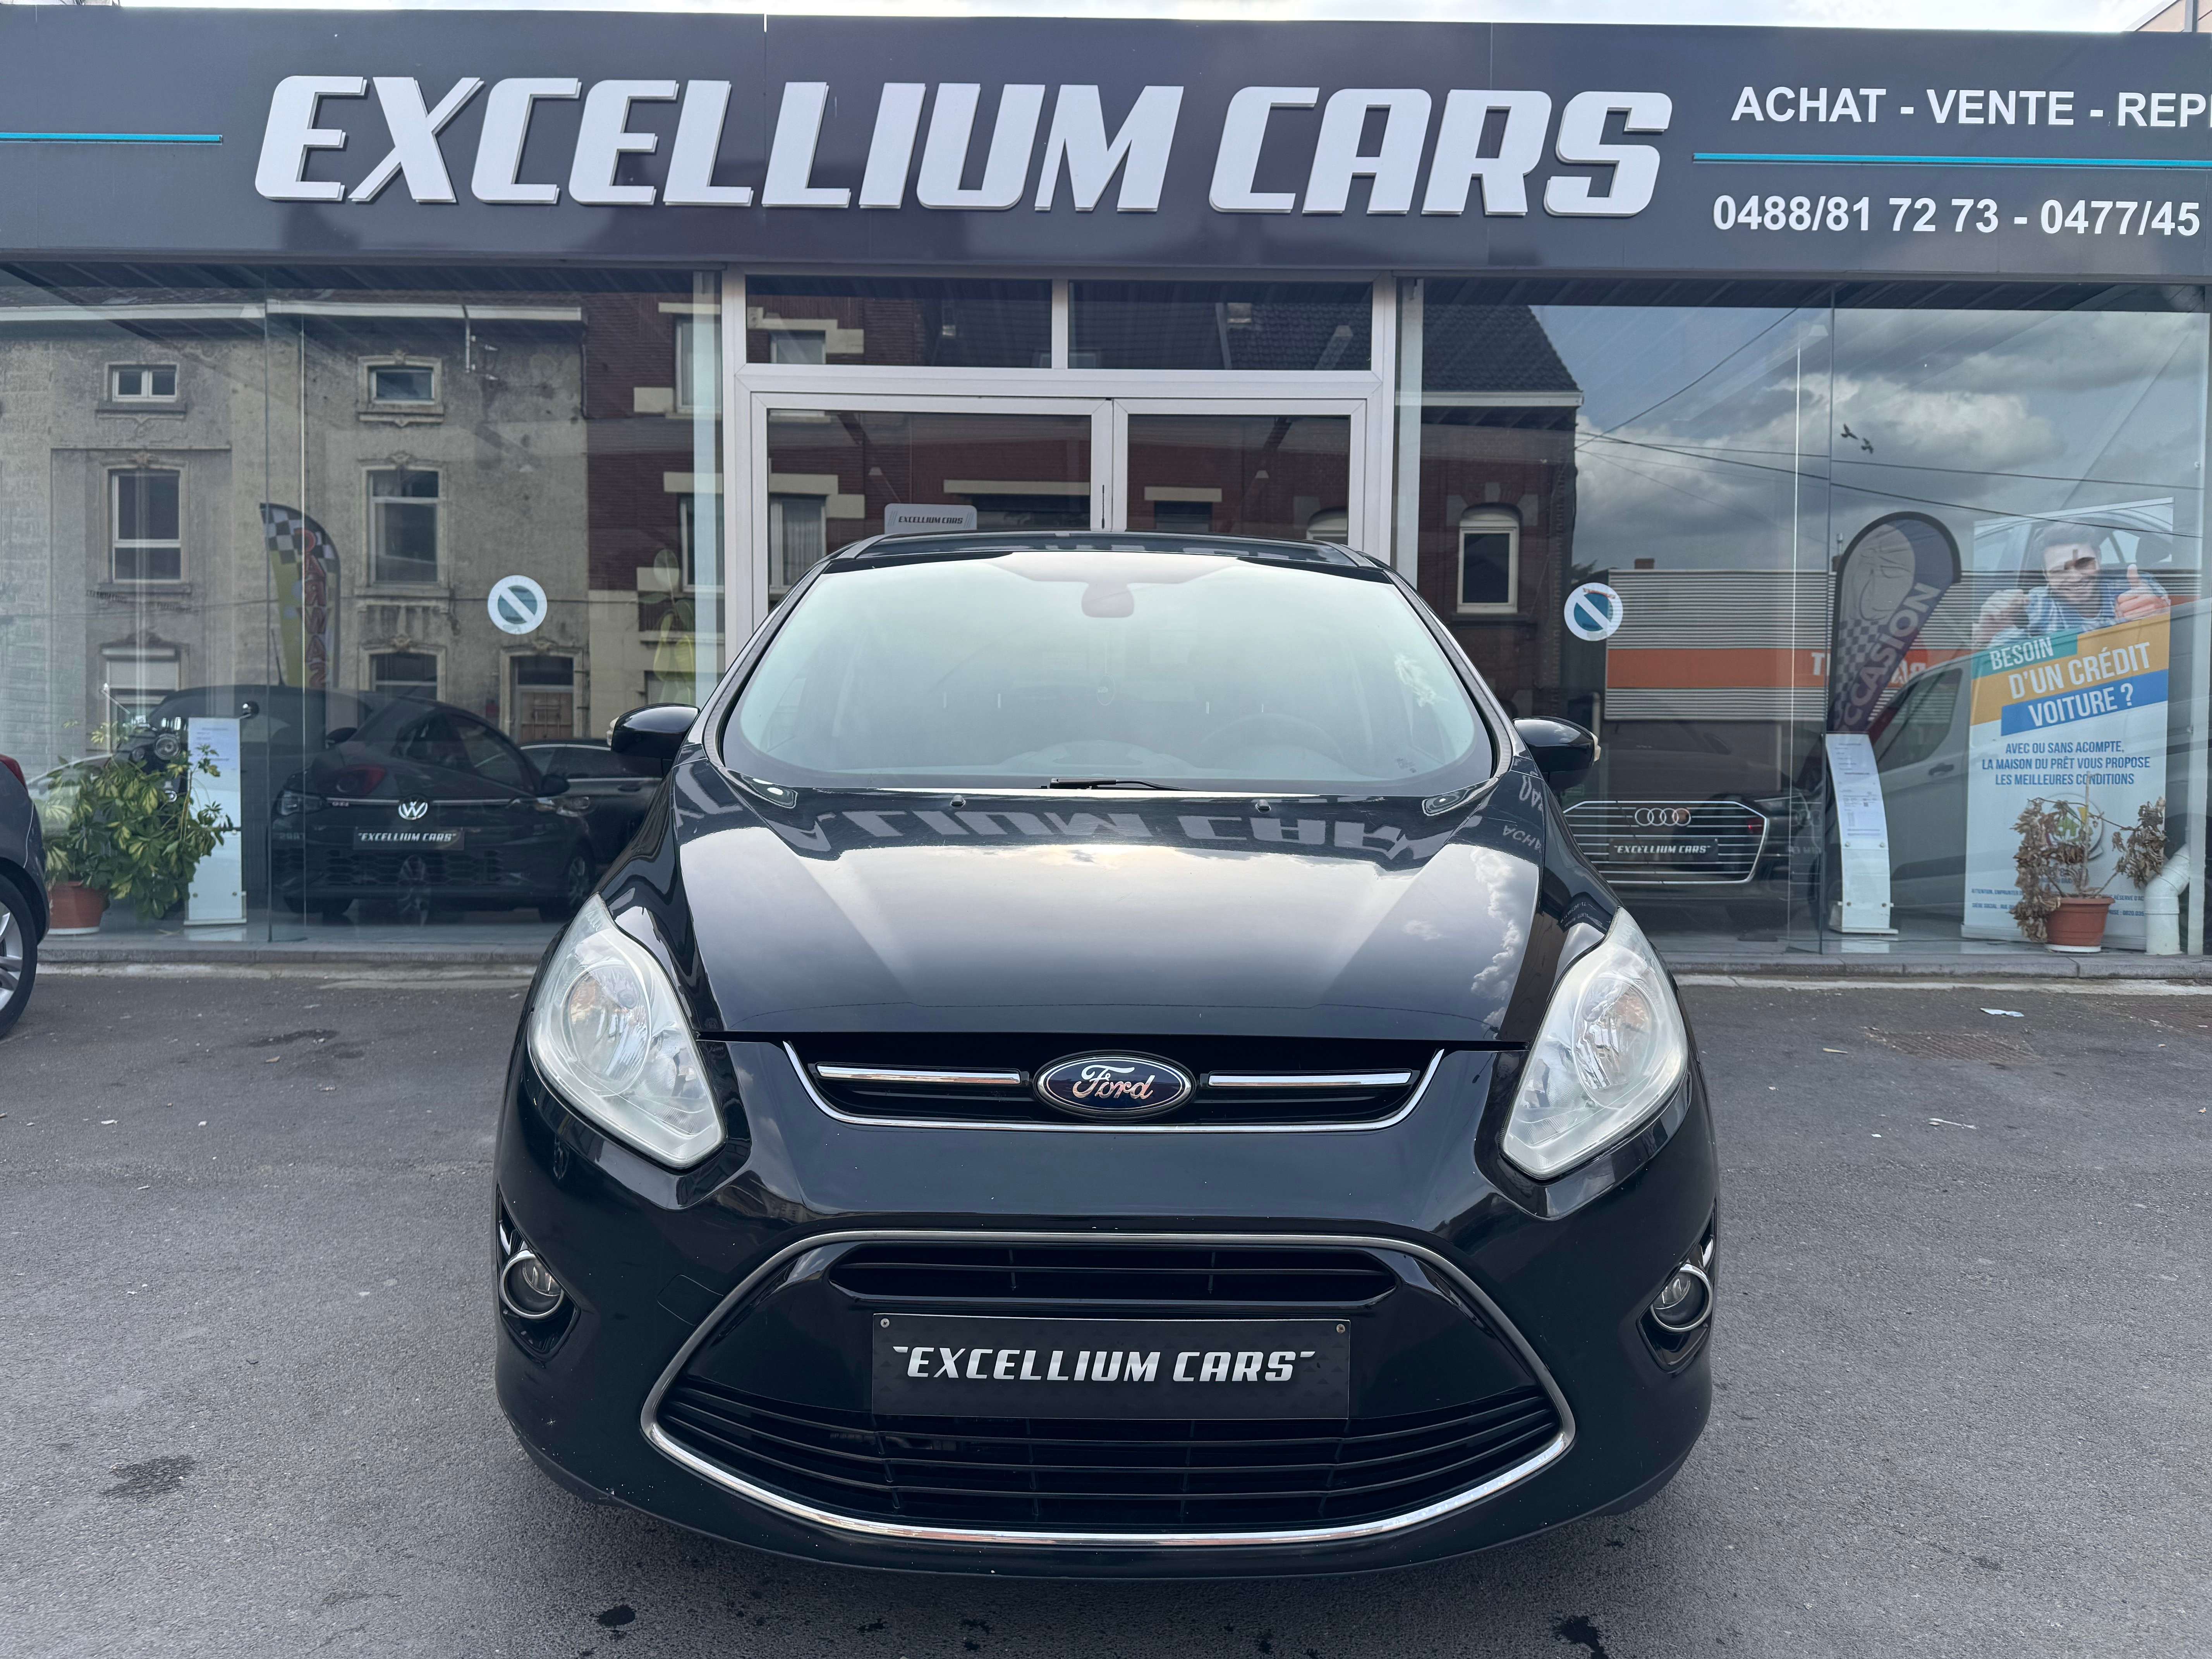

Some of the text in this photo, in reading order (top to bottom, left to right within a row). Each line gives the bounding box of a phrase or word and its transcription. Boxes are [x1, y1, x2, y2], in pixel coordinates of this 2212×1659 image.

[1731, 86, 1886, 122] ACHAT
[1927, 89, 2074, 125] VENTE
[2118, 92, 2212, 127] REP
[255, 76, 1672, 214] EXCELLIUM CARS
[1714, 195, 1869, 231] 0488/81
[1889, 198, 1936, 232] 72
[1951, 199, 1998, 233] 73
[2041, 199, 2200, 236] 0477/45
[1838, 582, 1942, 729] CCASION
[1989, 637, 2054, 670] BESOIN
[2008, 642, 2150, 699] D'UN CRÉDIT
[2028, 687, 2118, 727] VOITURE
[1982, 756, 2150, 769] LA MAISON DU PRÊT VOUS PROPOSE
[2006, 741, 2124, 754] AVEC OU SANS ACOMPTE,
[1996, 773, 2134, 785] LES MEILLEURES CONDITIONS
[1072, 1064, 1156, 1099] Ford
[907, 1347, 1296, 1381] EXCELLIUM CARS
